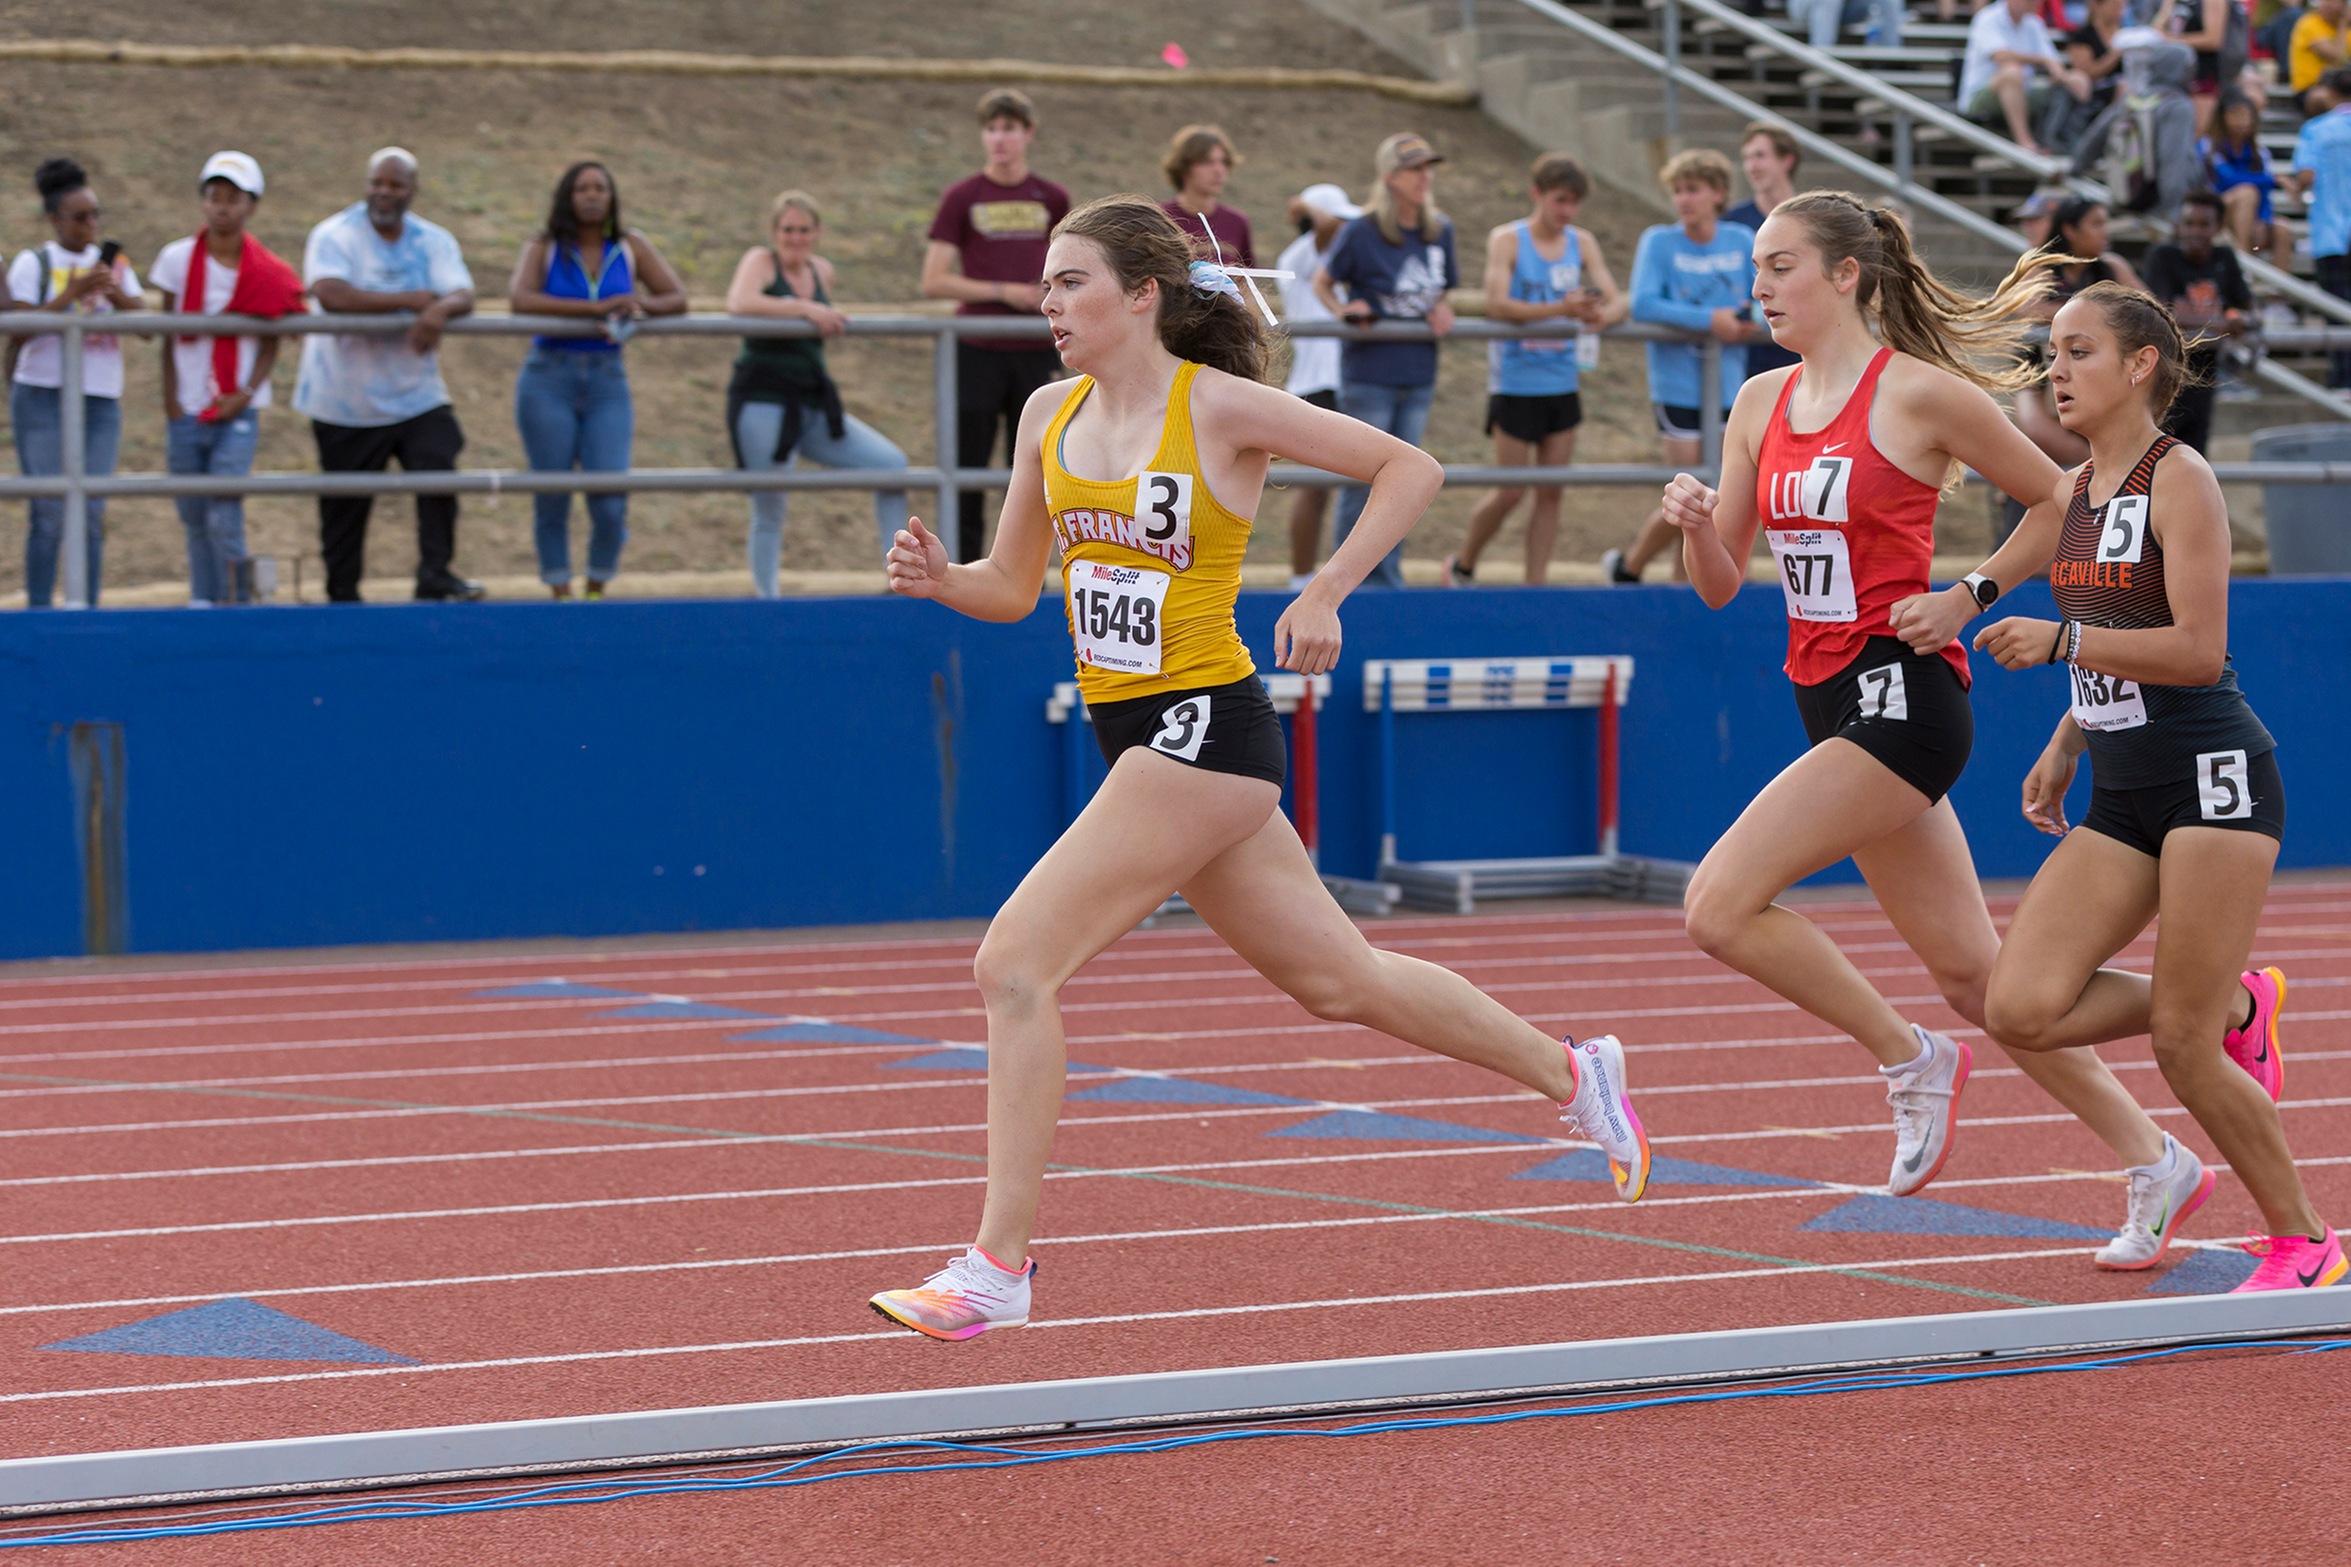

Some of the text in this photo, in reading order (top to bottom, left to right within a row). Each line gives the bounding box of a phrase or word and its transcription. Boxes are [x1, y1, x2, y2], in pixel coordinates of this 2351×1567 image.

[1145, 475, 1179, 541] 3
[1771, 470, 1809, 519] LO
[1816, 460, 1842, 516] 7
[1784, 532, 1822, 548] MileSplit
[2106, 499, 2137, 558] 5
[1091, 565, 1140, 586] MileSplit
[1783, 553, 1834, 597] 677
[1074, 587, 1156, 647] 1543
[1866, 667, 1893, 717] 7
[2071, 664, 2137, 707] 1632
[1159, 701, 1200, 751] 3
[2210, 755, 2240, 817] 5
